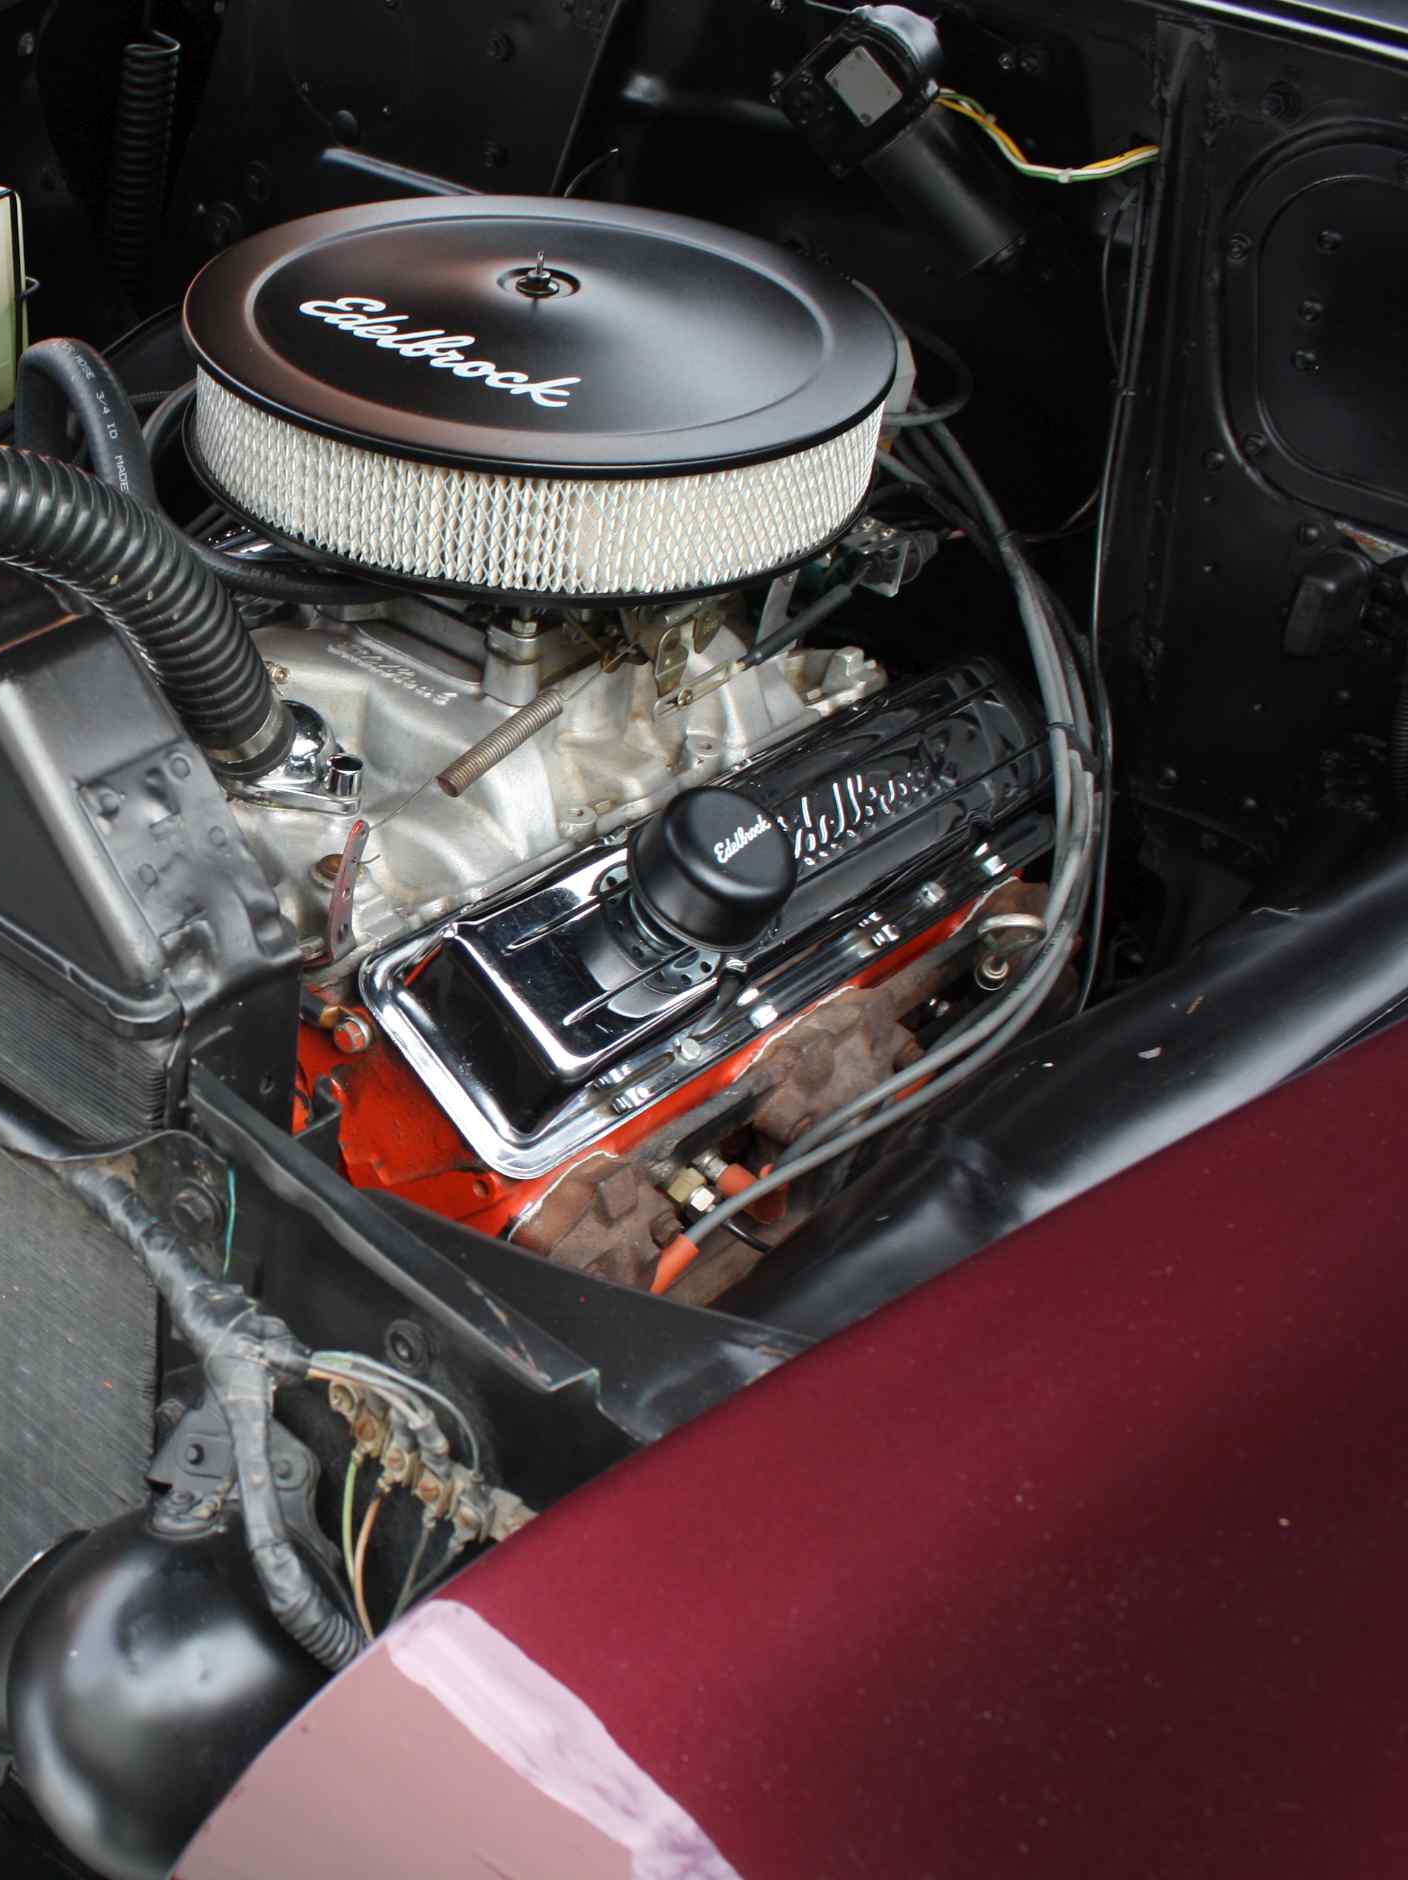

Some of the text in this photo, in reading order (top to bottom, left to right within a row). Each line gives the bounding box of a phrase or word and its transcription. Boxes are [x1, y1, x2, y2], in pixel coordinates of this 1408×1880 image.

[298, 296, 583, 407] Edelbrock
[96, 391, 111, 415] 3/4
[107, 423, 118, 440] ID
[115, 455, 128, 493] MADE
[712, 813, 772, 865] Edelbrock
